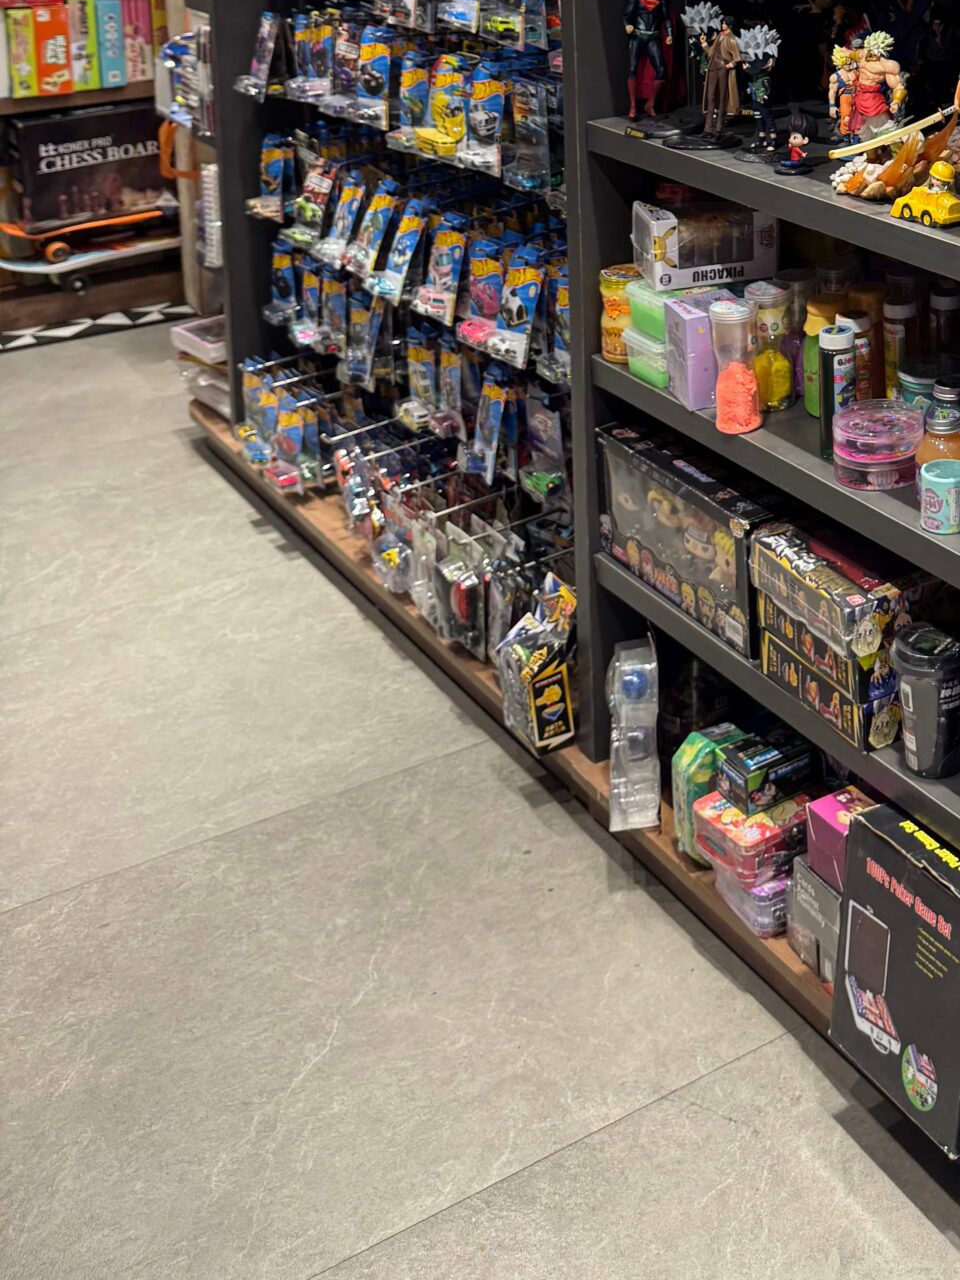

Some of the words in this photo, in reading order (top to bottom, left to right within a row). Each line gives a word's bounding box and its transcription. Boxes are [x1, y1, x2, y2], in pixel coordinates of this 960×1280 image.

[39, 148, 102, 173] CHESS
[692, 266, 744, 282] PIKACHU
[914, 830, 940, 851] Game
[890, 876, 914, 908] Poker
[915, 895, 937, 927] Game
[938, 914, 953, 941] Set
